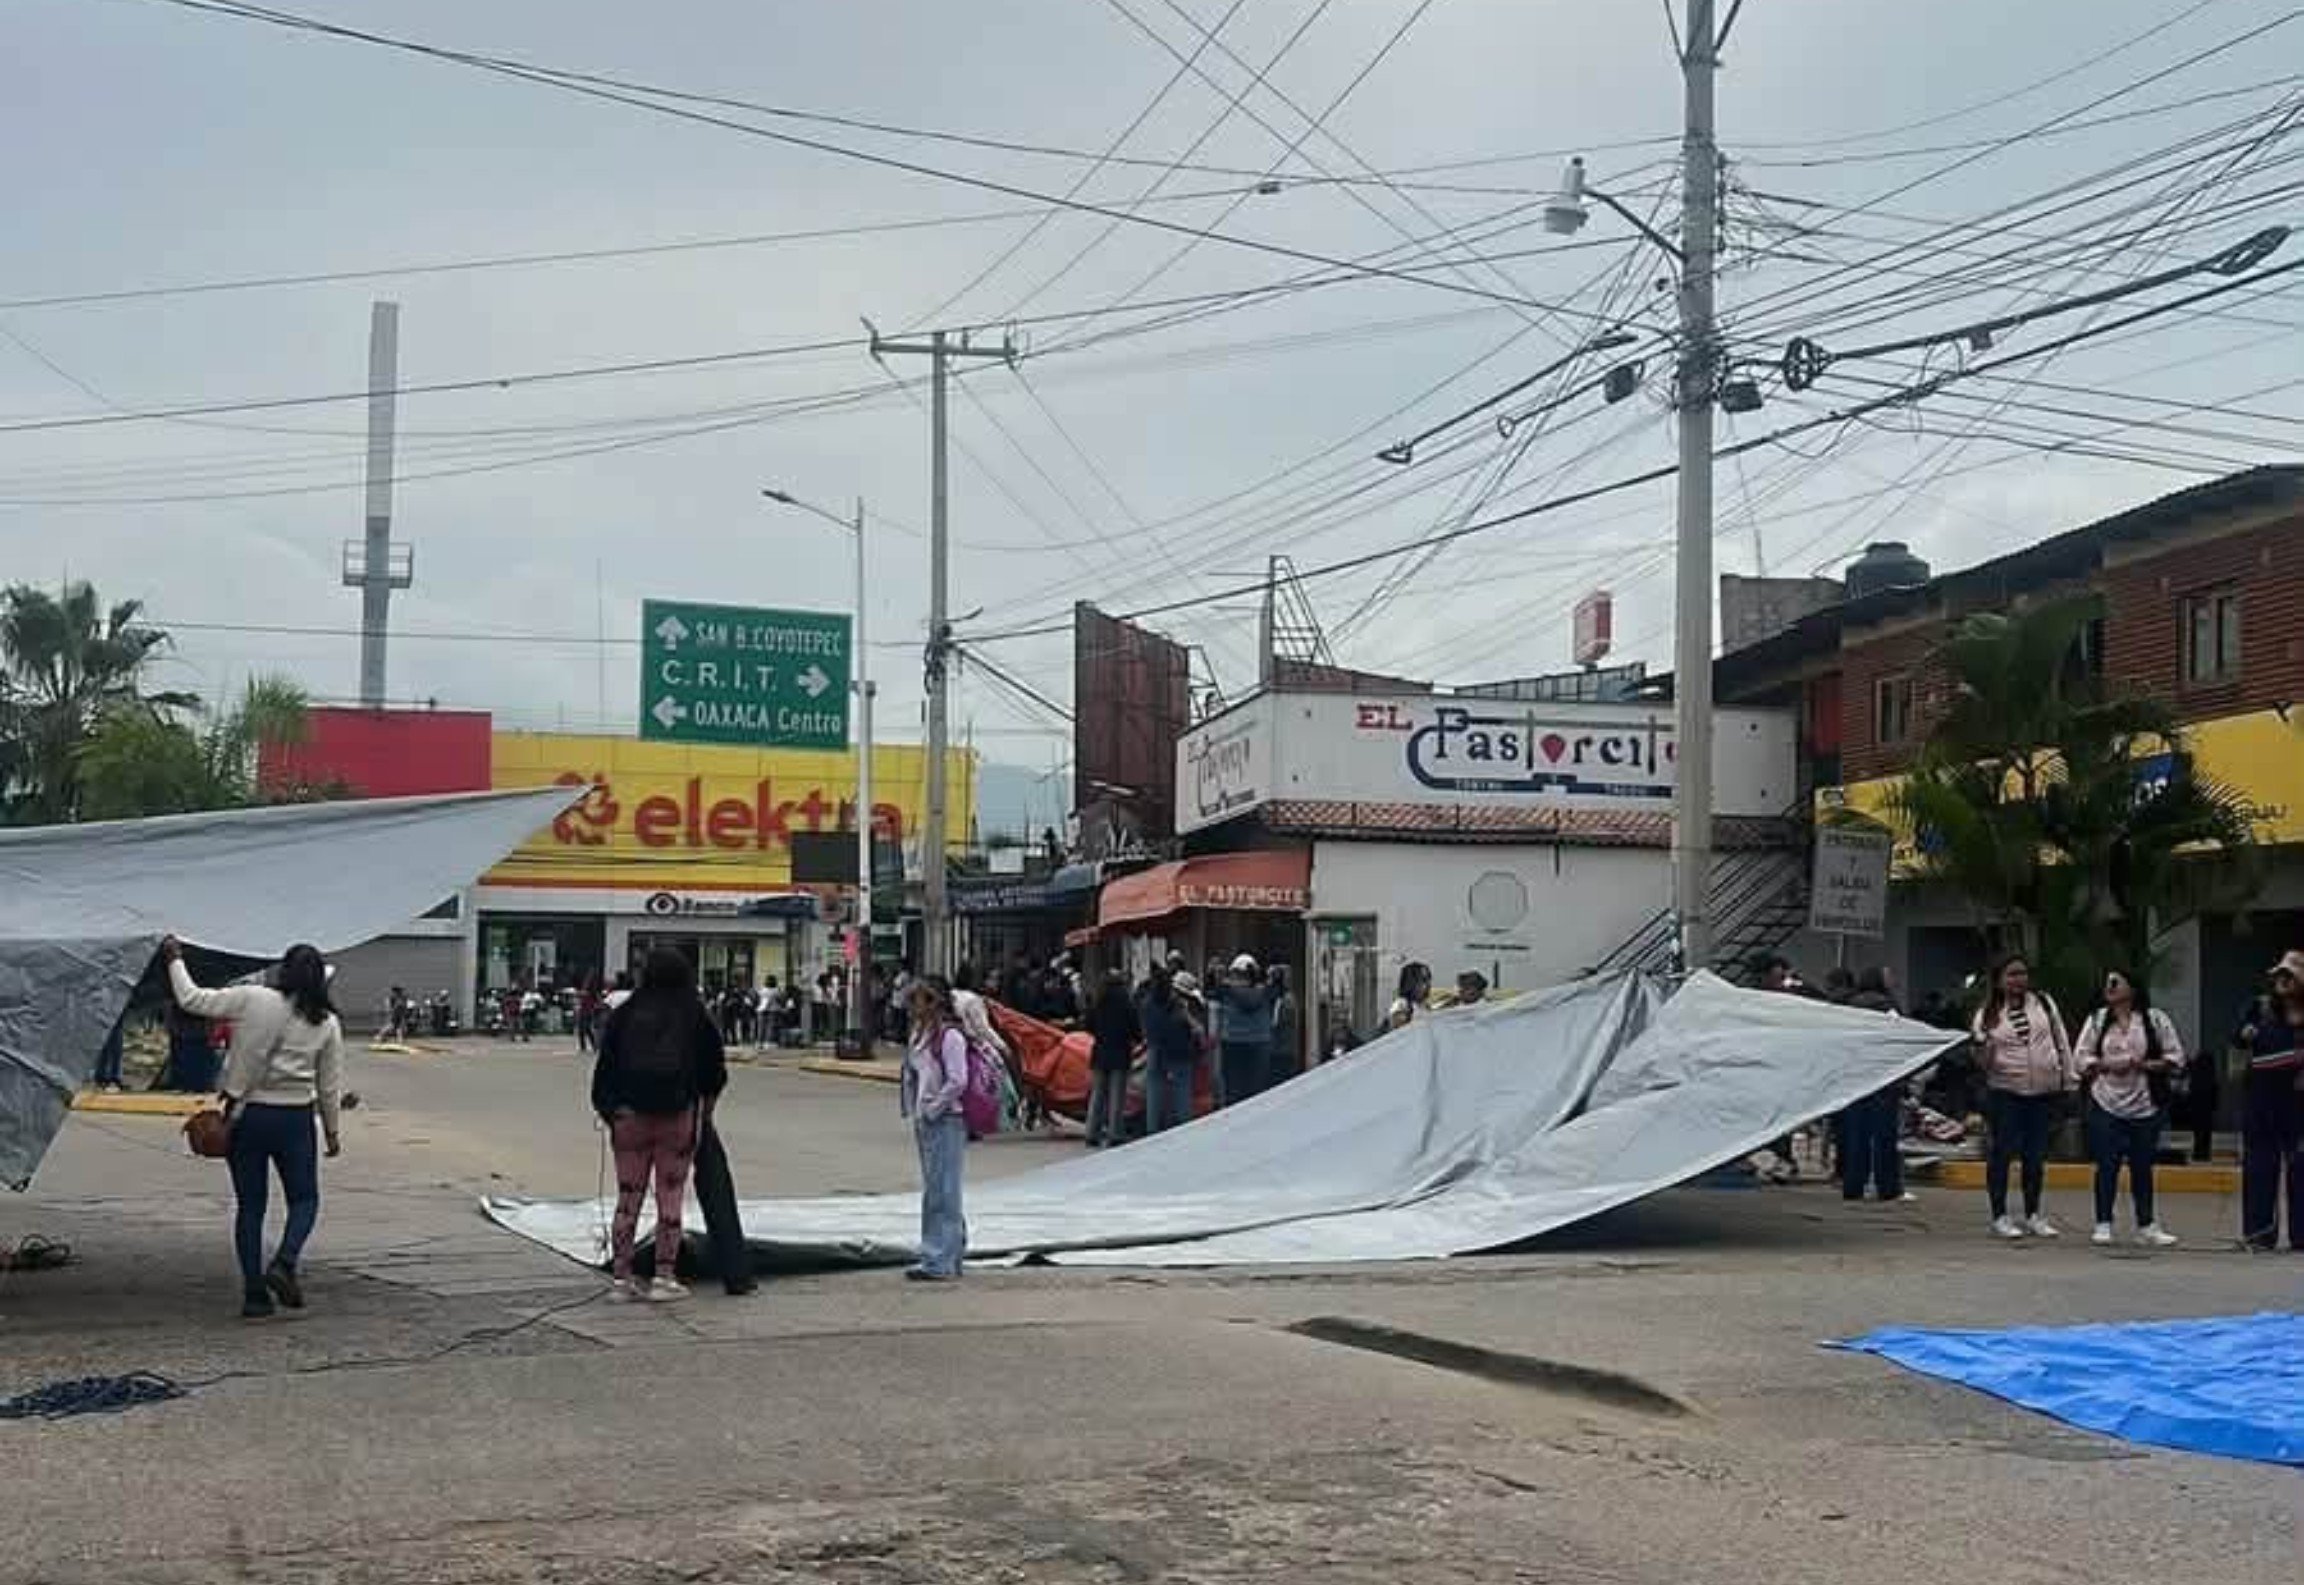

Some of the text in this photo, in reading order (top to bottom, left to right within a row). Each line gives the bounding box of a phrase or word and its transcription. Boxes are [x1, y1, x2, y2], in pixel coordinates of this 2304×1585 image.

[696, 621, 729, 647] SAN
[695, 700, 842, 734] OAXACA Centro
[1355, 703, 1413, 730] EL
